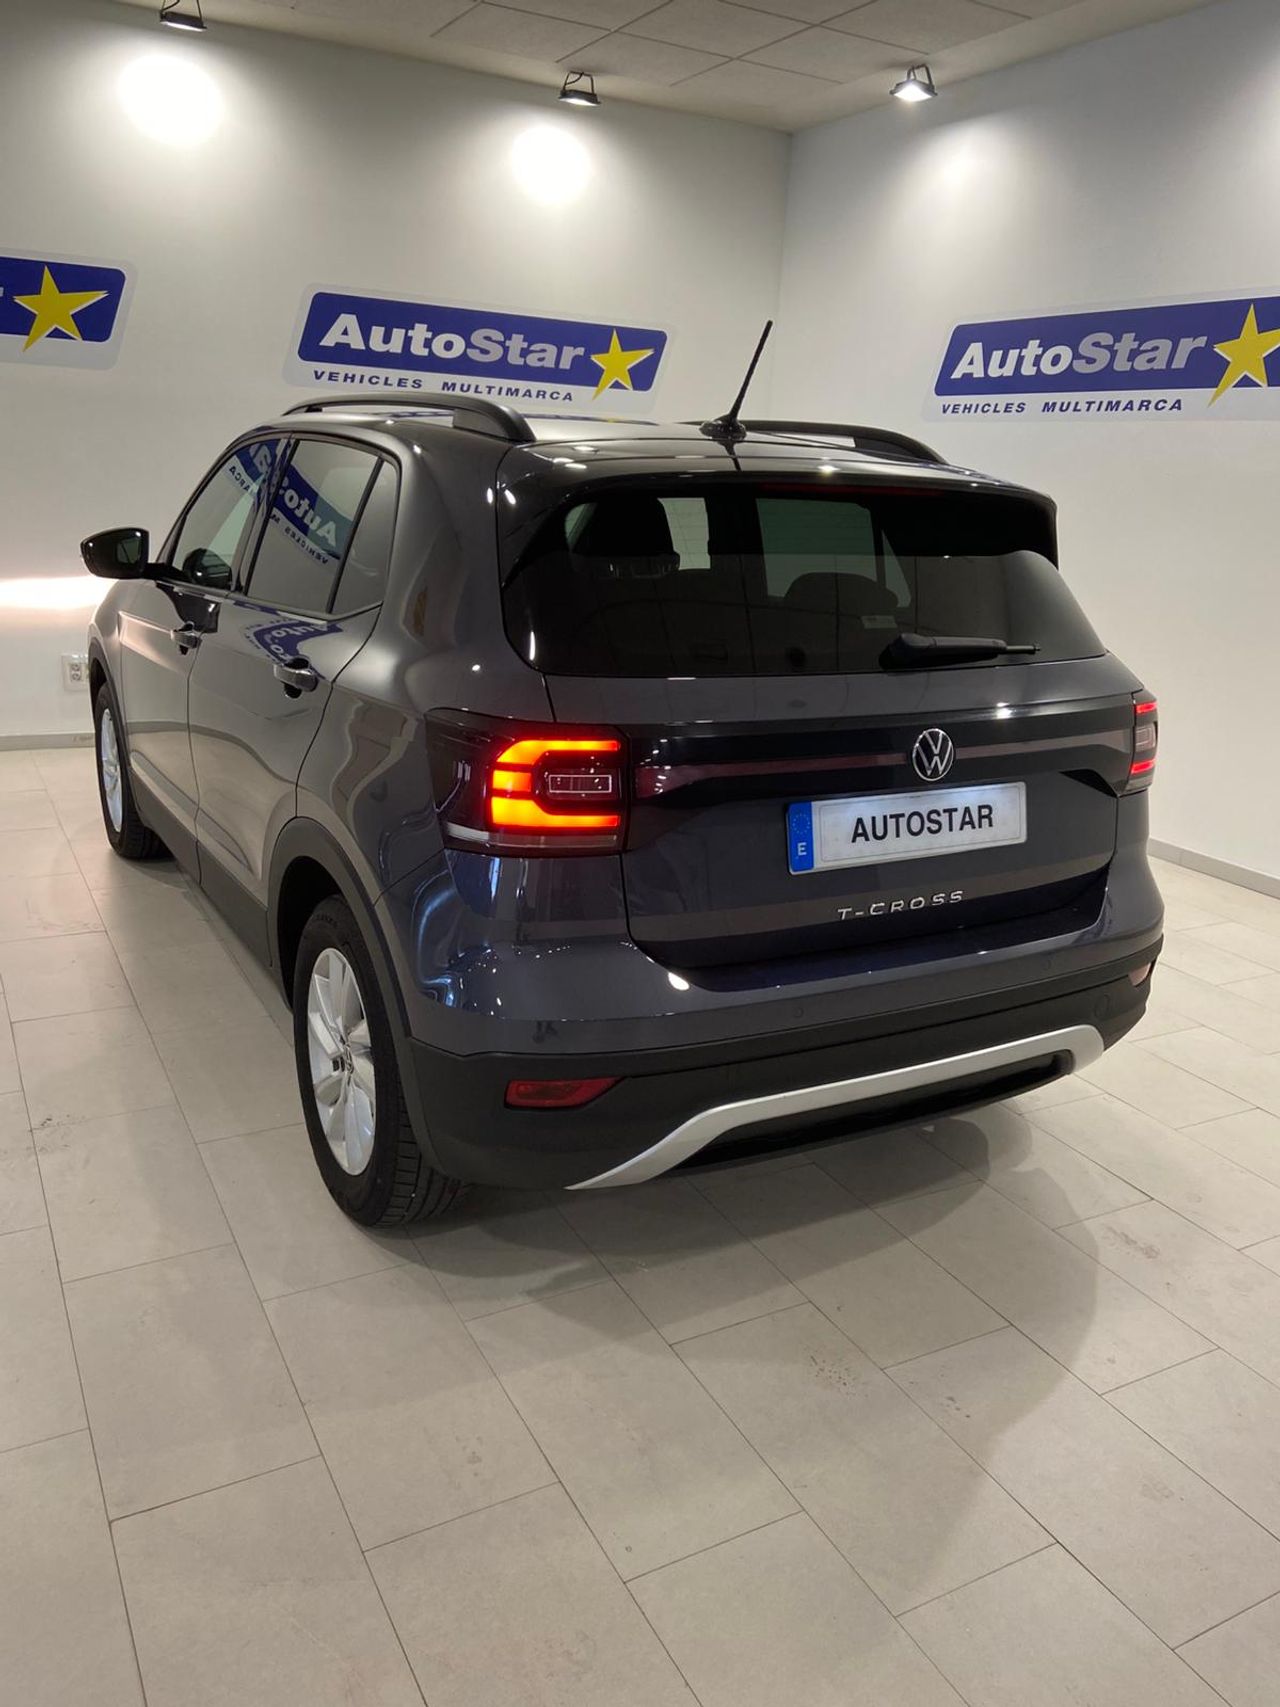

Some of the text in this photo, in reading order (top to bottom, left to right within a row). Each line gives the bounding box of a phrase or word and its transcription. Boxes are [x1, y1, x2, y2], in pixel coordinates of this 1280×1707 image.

[319, 313, 586, 370] AutoStar
[950, 332, 1208, 380] AutoStar
[313, 370, 575, 402] VEHICLES MULTIMARCA
[941, 398, 1183, 415] VEHICLES MULTIMARCA
[851, 804, 994, 843] AUTOSTAR
[797, 842, 807, 856] E
[837, 890, 964, 920] T-CROSS
